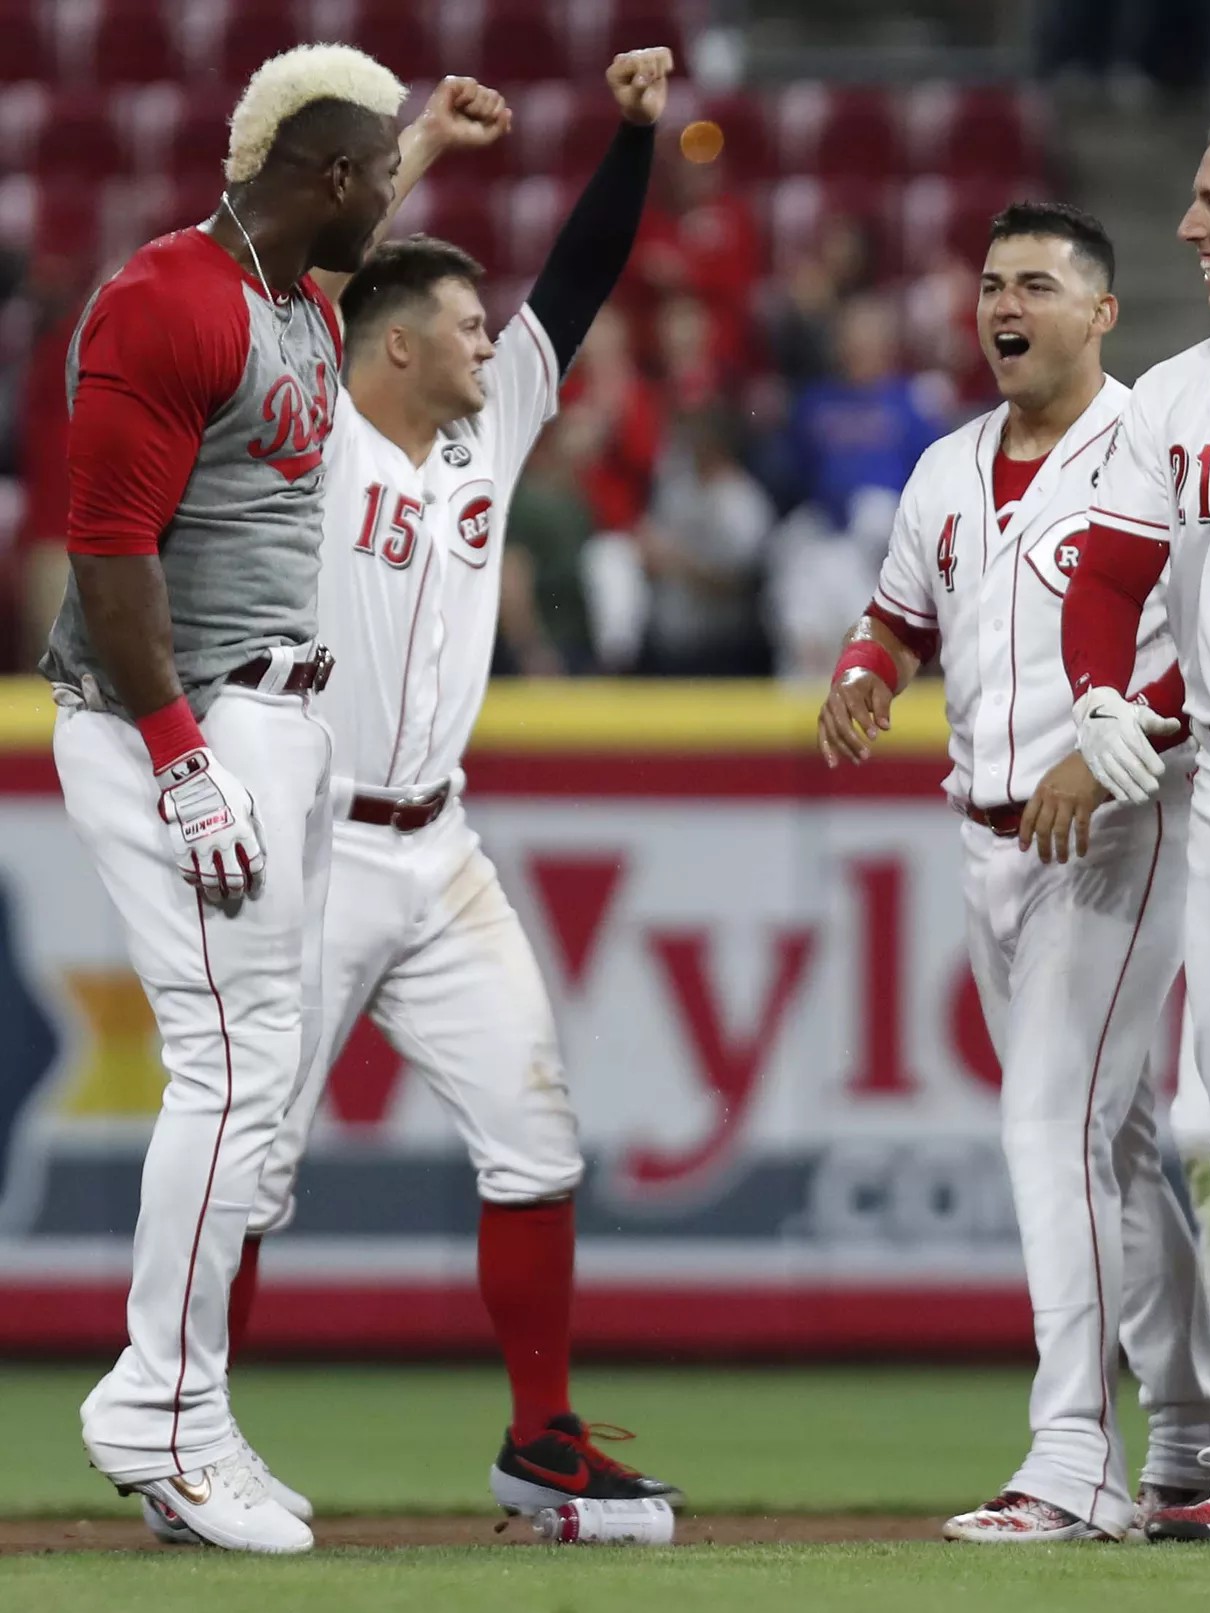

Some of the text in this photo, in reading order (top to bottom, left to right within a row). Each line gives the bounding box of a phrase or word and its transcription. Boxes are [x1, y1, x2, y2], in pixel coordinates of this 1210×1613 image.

[442, 445, 470, 465] 20
[353, 480, 425, 571] 15
[937, 511, 963, 593] 4
[185, 808, 229, 837] Franklin
